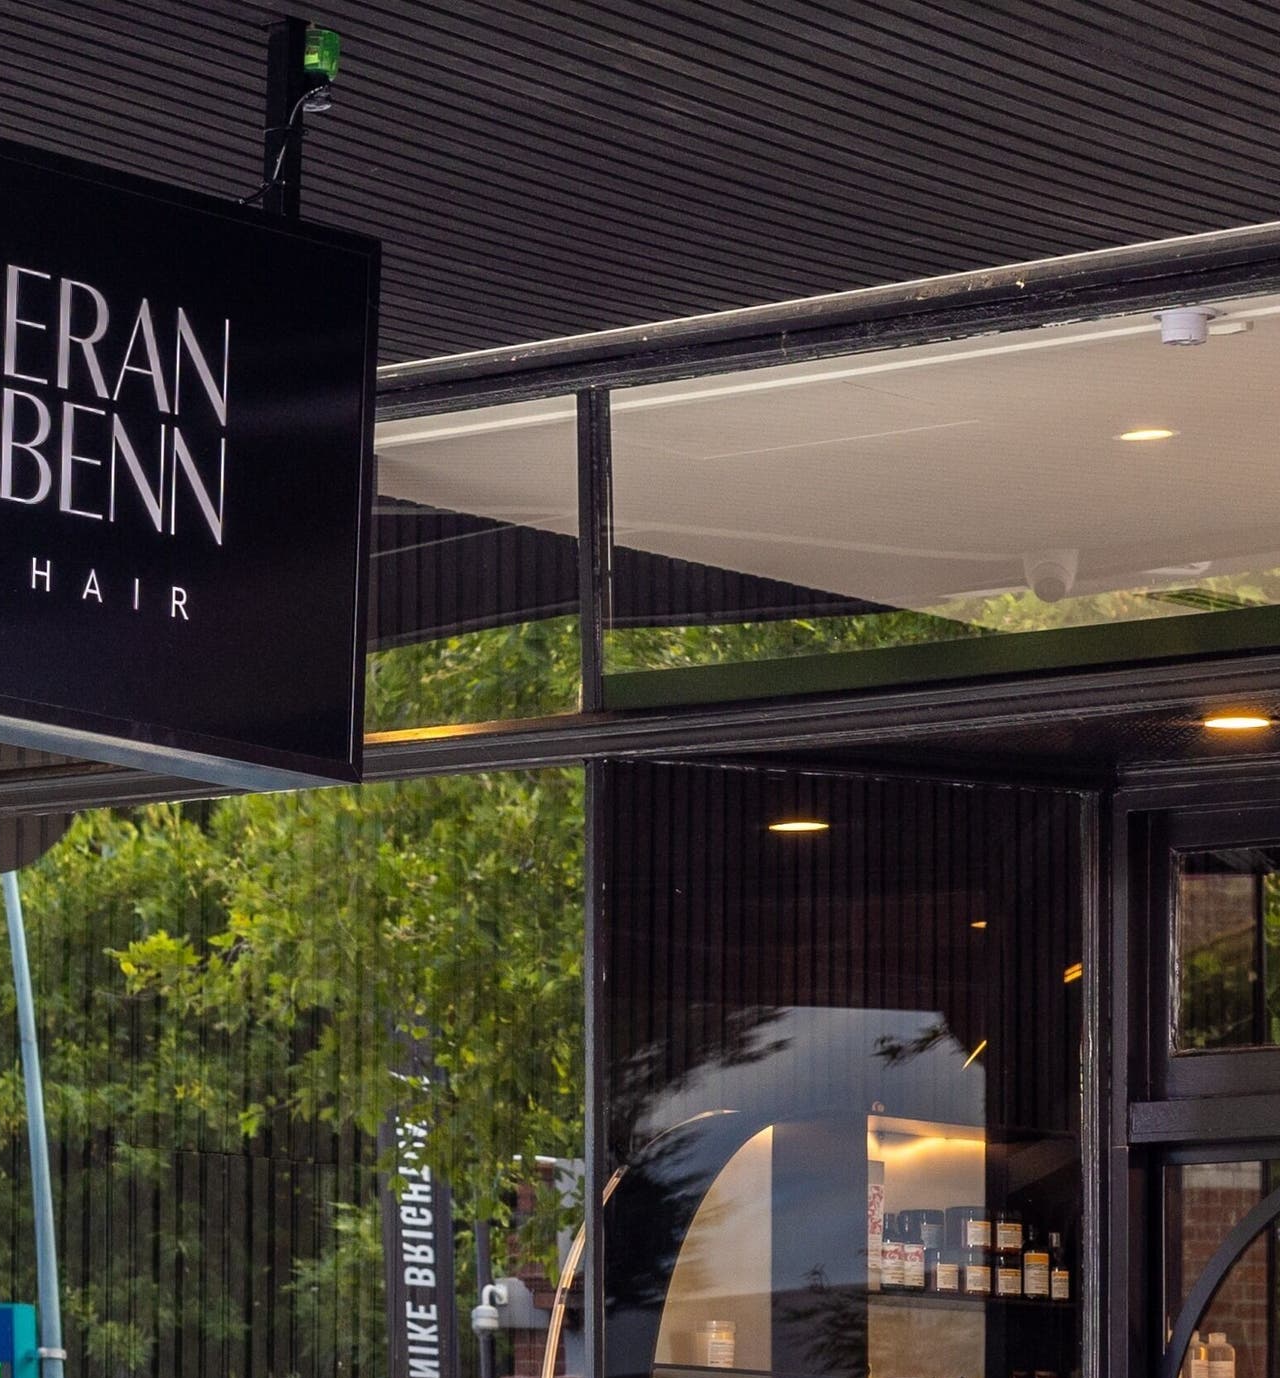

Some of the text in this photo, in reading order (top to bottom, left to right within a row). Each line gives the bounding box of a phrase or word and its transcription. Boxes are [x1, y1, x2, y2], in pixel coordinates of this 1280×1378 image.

[3, 263, 229, 427] ERAN
[0, 387, 226, 546] BENN
[31, 556, 189, 620] HAIR
